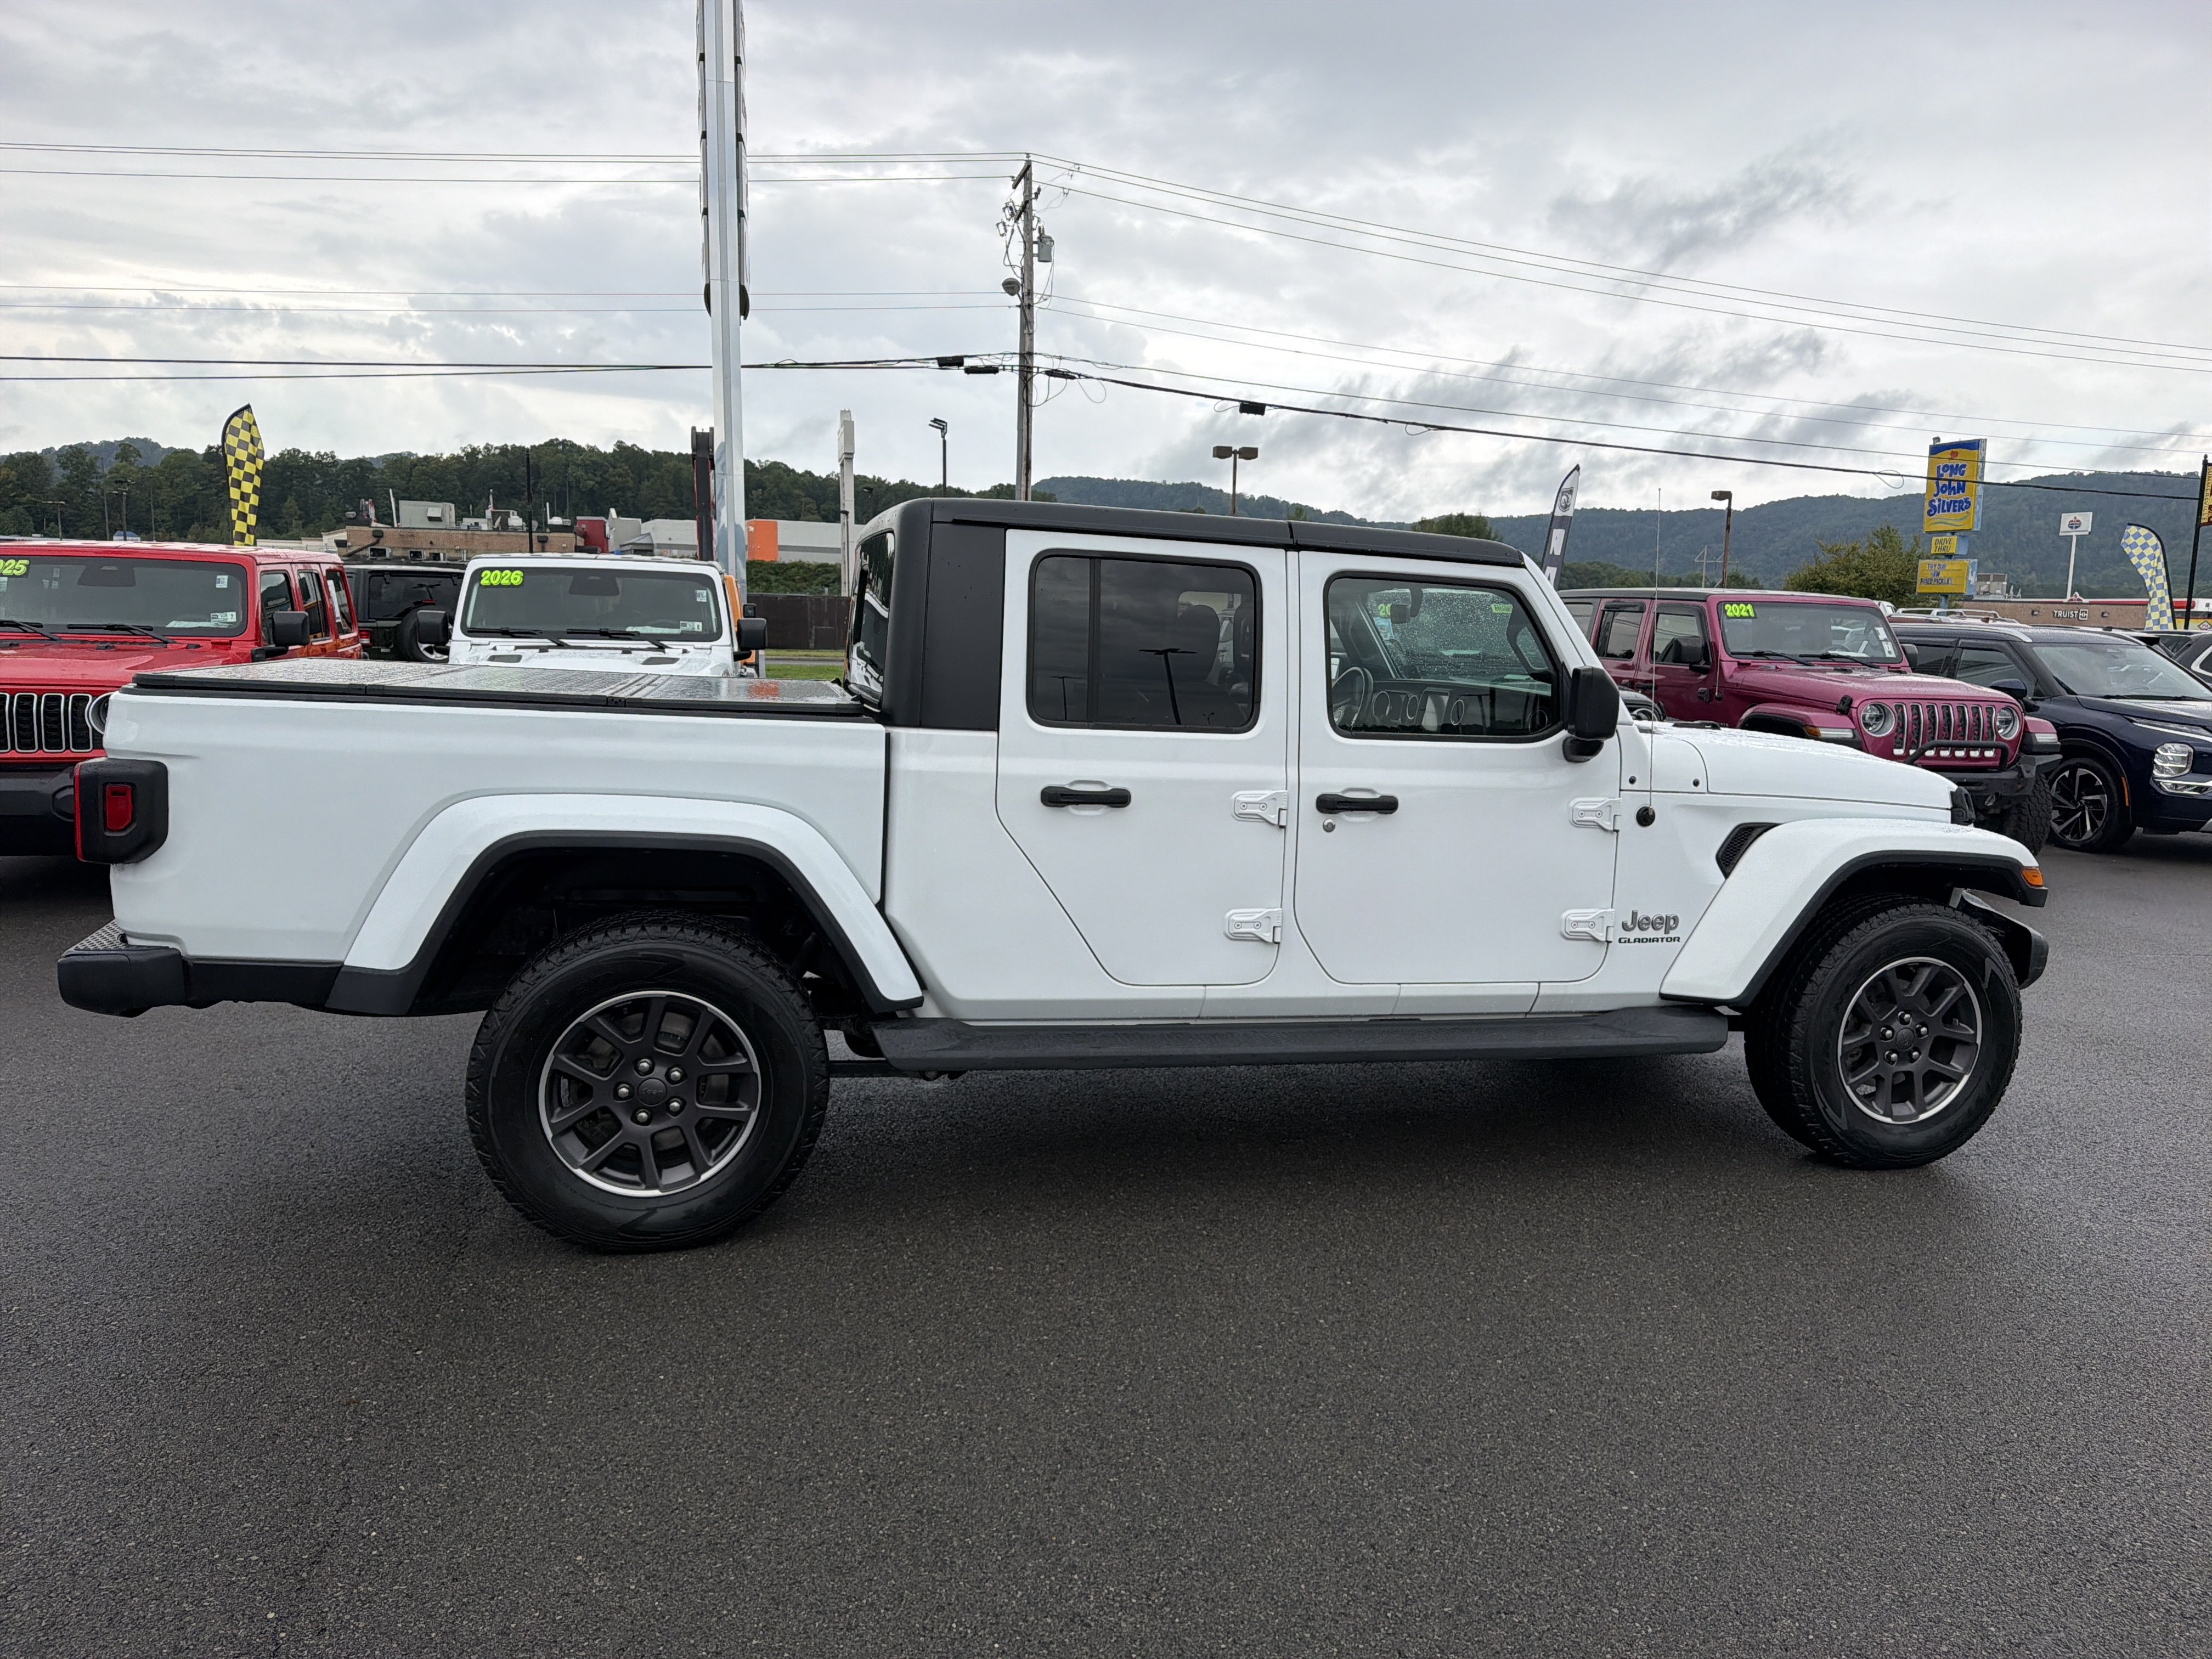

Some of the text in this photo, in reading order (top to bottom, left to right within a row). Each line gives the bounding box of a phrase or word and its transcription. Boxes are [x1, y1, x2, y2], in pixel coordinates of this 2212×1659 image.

[481, 570, 523, 586] 2026
[1724, 603, 1754, 617] 2021
[2053, 610, 2079, 618] TRUIST
[1622, 910, 1679, 934] Jeep
